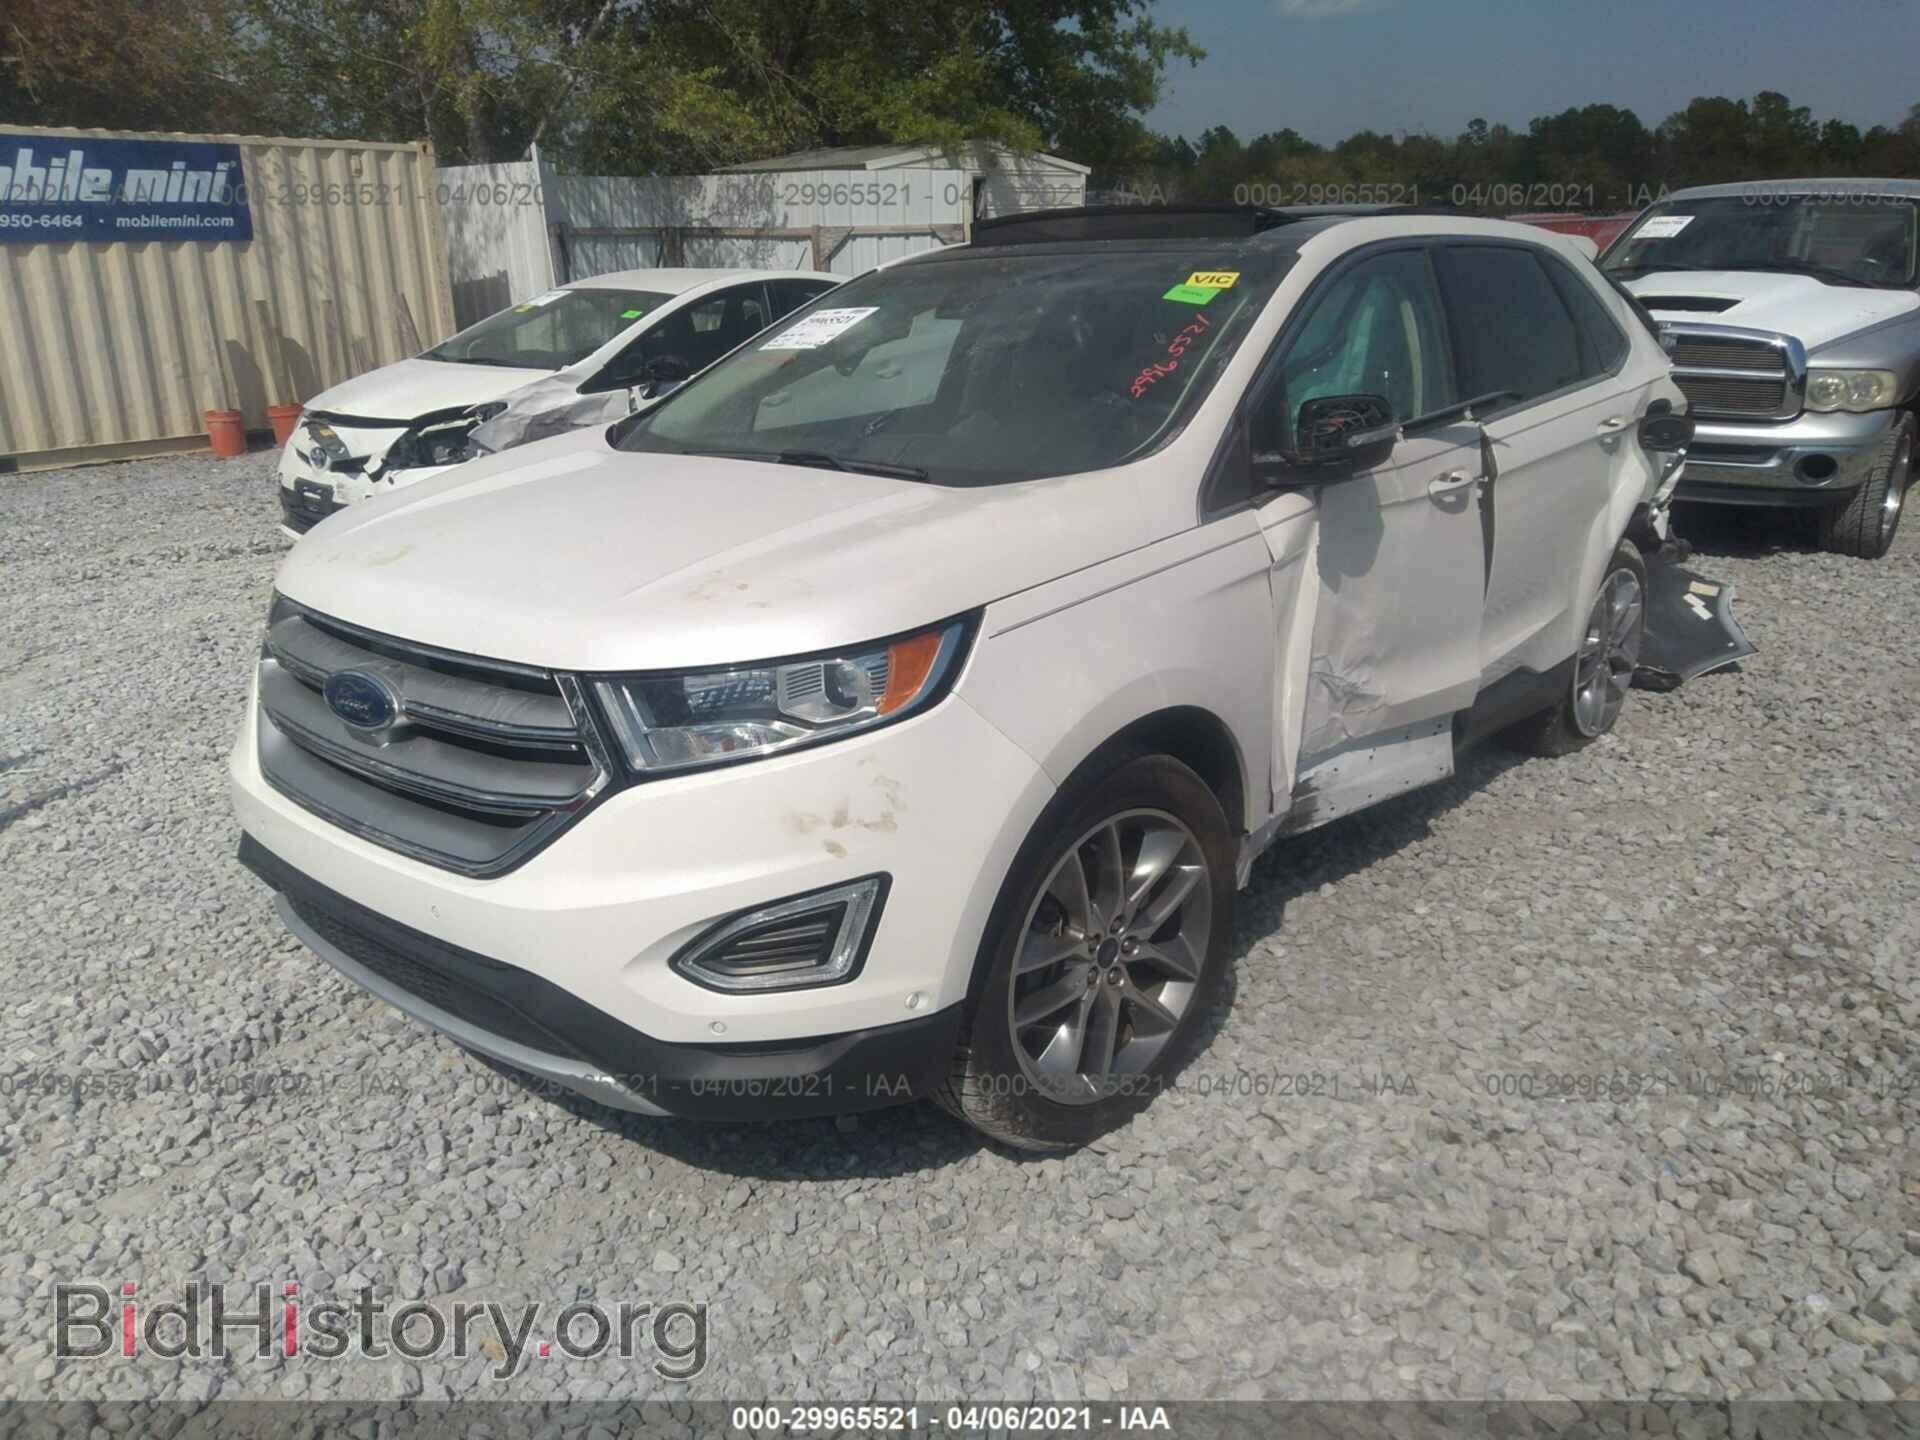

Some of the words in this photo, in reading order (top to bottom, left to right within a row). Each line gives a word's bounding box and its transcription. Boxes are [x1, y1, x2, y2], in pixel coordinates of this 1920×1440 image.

[122, 161, 229, 202] mini
[0, 214, 82, 228] 950-6464
[116, 214, 234, 228] mobilemini.com
